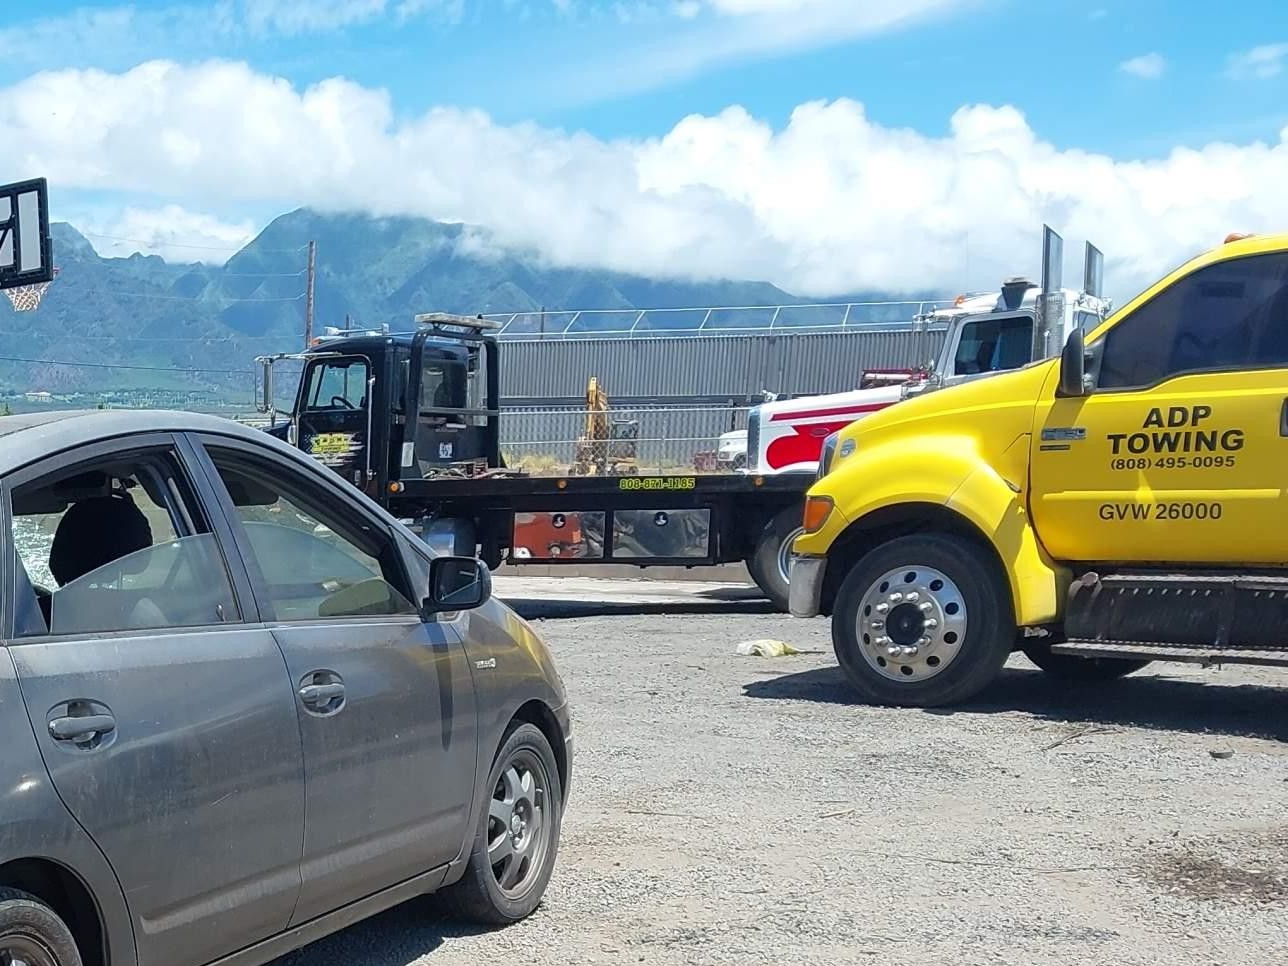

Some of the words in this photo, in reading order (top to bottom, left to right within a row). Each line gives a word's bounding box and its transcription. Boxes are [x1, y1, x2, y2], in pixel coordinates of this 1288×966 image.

[1142, 405, 1212, 429] ADP
[1107, 429, 1245, 454] TOWING
[1111, 458, 1152, 470] (808)
[1155, 455, 1236, 469] 495-0095
[619, 477, 696, 489] 808-871-1185
[1098, 503, 1152, 520] GVW
[1155, 502, 1222, 520] 26000
